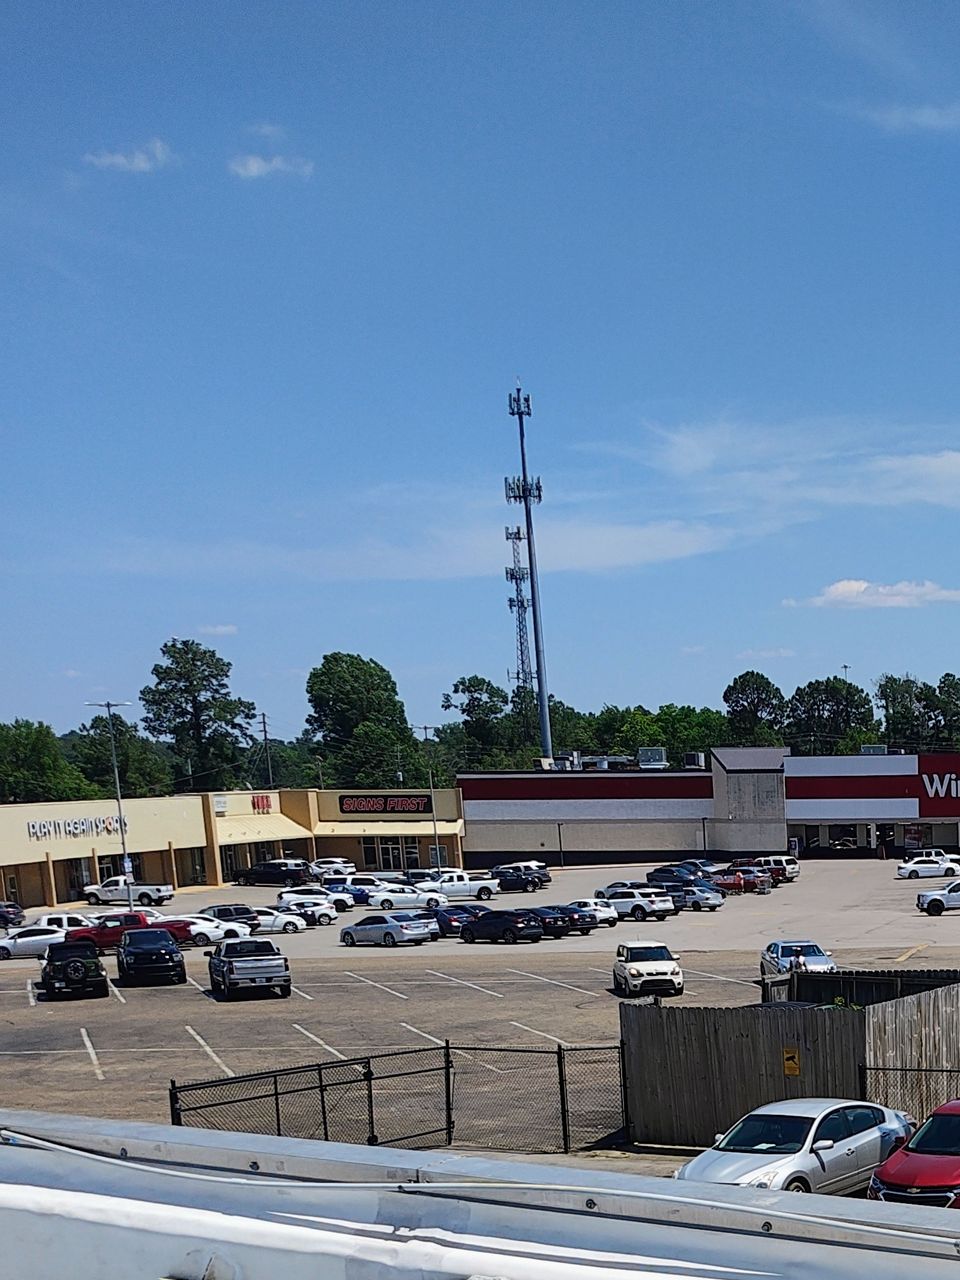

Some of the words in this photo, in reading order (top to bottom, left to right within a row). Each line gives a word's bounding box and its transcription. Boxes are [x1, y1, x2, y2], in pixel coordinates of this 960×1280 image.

[343, 797, 385, 811] SIGNS
[387, 797, 428, 811] FIRST
[28, 820, 53, 838] PLAY
[64, 817, 94, 835] AGAIN
[95, 816, 128, 833] SPORS
